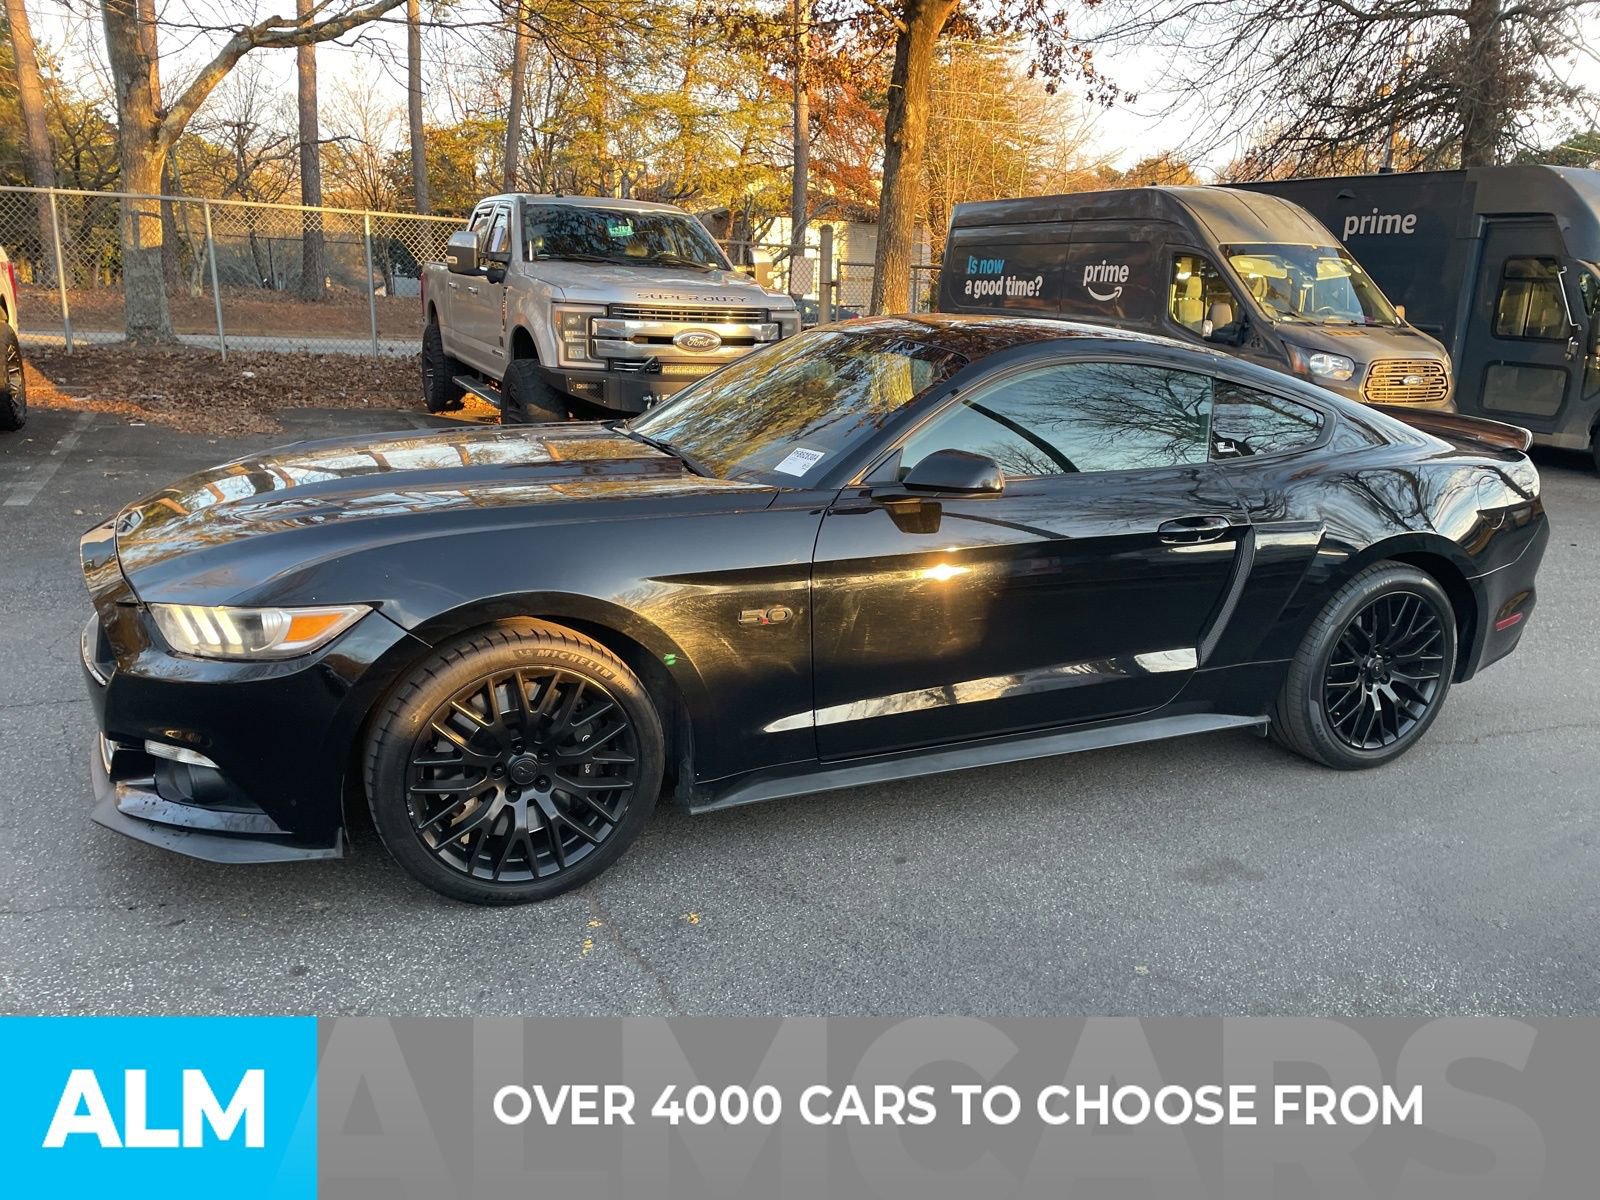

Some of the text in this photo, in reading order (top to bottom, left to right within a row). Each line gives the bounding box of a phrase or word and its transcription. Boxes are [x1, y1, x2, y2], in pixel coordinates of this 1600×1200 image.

[1342, 207, 1417, 241] prime
[967, 255, 1005, 274] Is now
[1083, 259, 1130, 287] prime
[636, 292, 699, 301] SUPER
[965, 275, 1044, 299] a good time?
[738, 604, 793, 625] 5.0
[536, 649, 613, 679] MICHELIN
